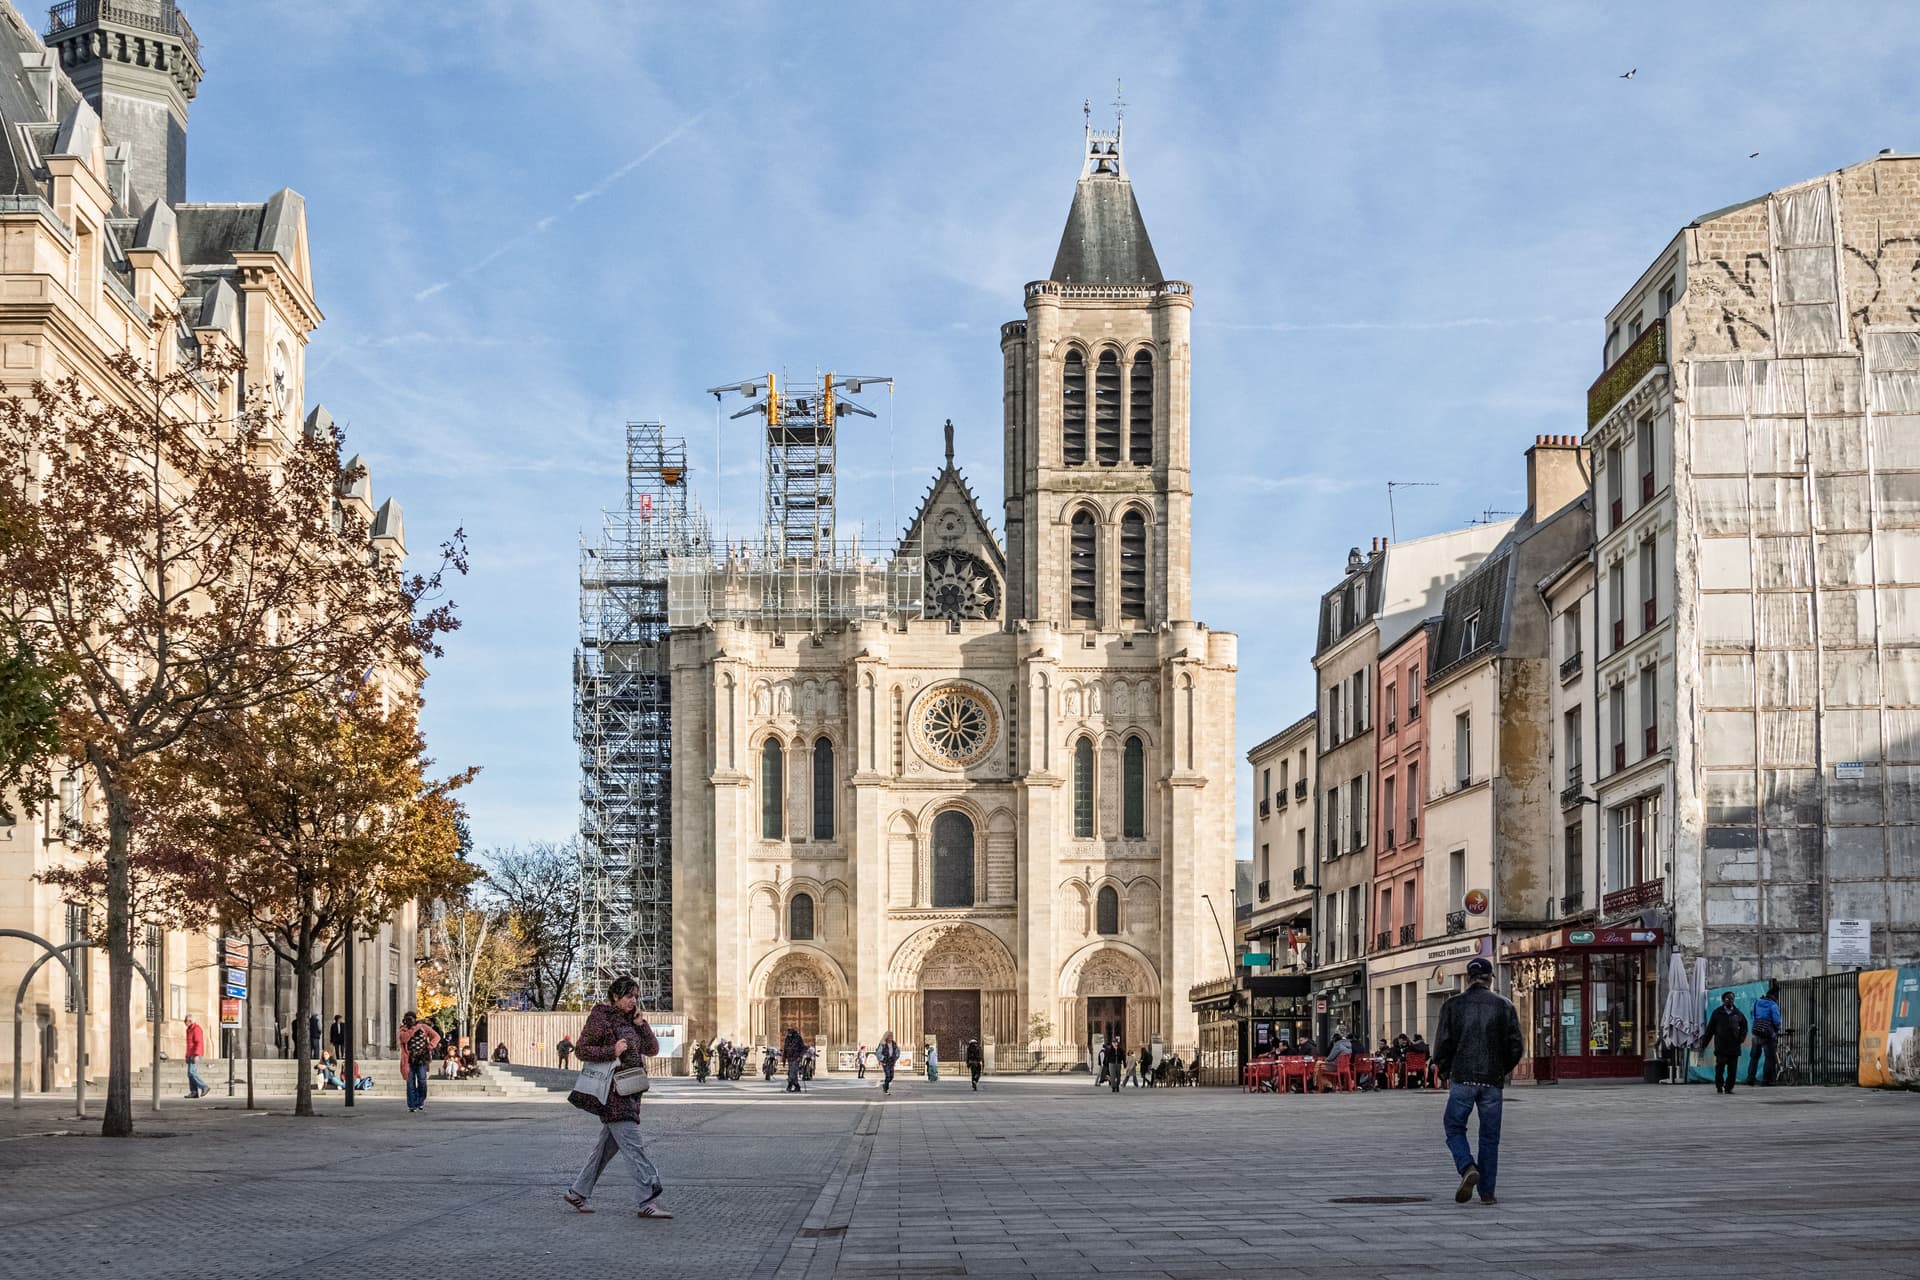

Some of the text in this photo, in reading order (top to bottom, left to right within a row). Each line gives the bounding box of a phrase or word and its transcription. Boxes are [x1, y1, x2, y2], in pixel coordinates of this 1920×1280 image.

[1602, 932, 1624, 943] Bar
[1428, 945, 1471, 959] SERVICES FUNÉRAIRES
